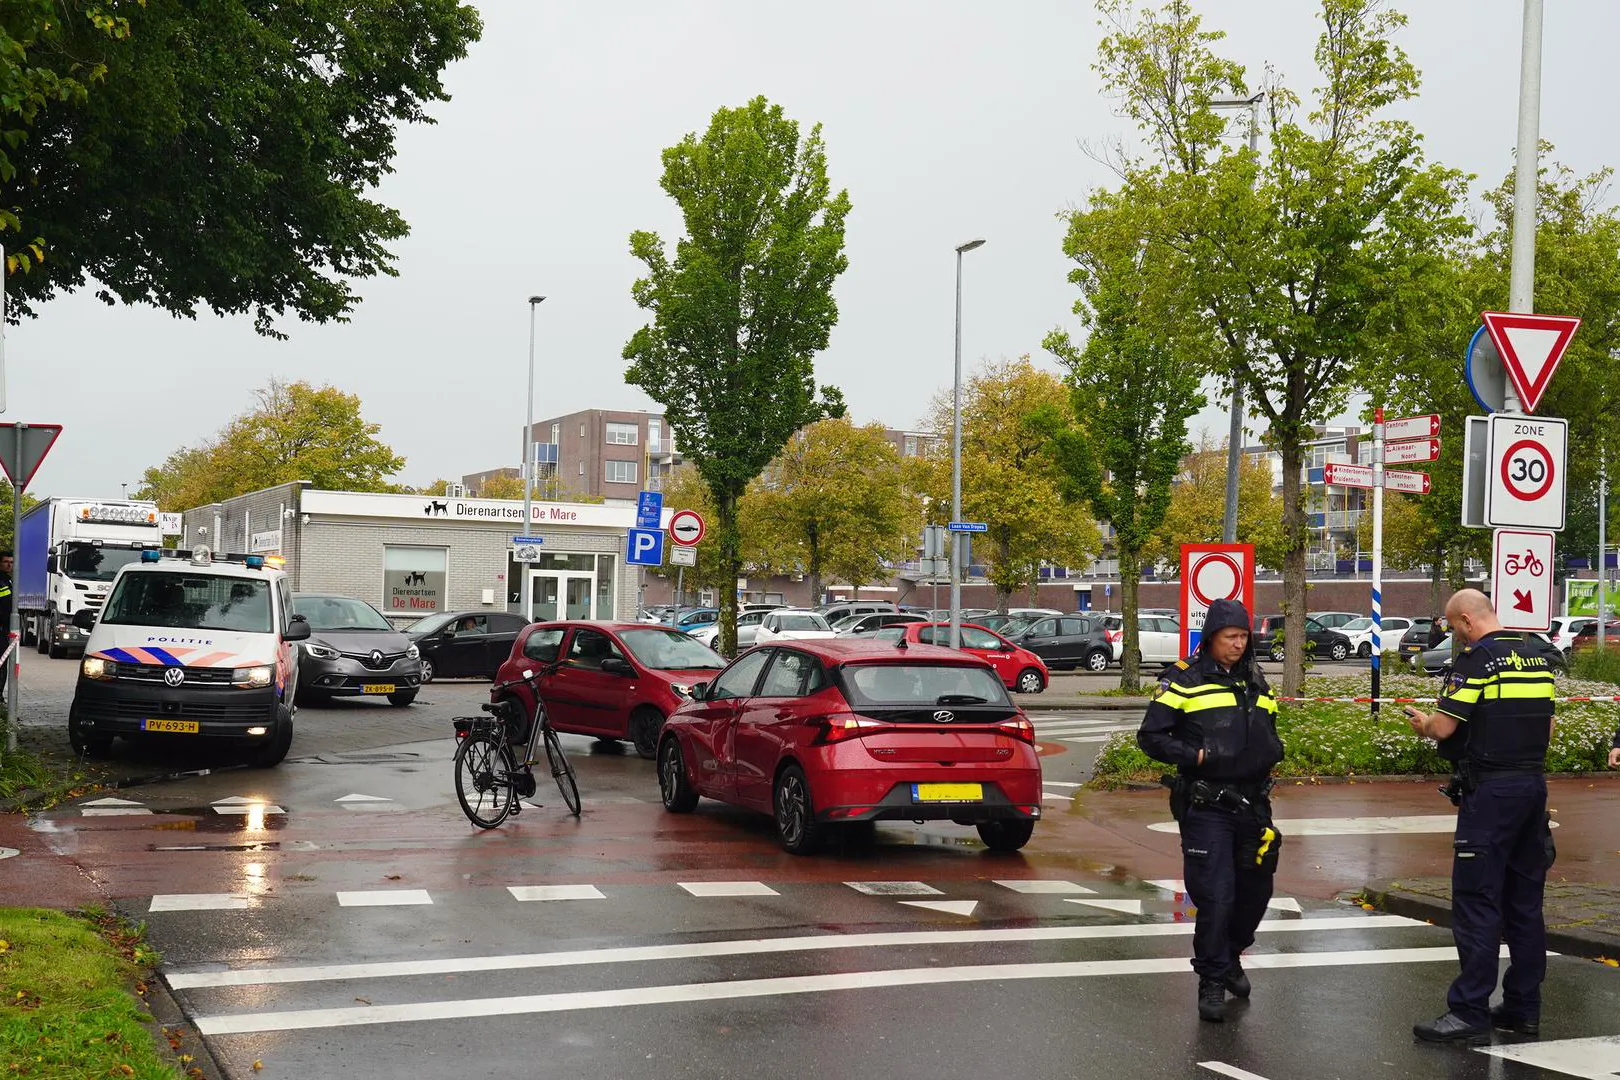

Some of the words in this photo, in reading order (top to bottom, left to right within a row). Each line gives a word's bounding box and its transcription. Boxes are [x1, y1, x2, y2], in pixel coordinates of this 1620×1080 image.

[1514, 424, 1545, 436] ZONE
[1511, 457, 1546, 483] 30
[456, 503, 525, 518] Dierenartsen
[532, 507, 546, 519] De
[550, 508, 577, 520] Mare
[634, 532, 656, 560] P
[392, 587, 436, 596] Dierenartsen
[513, 592, 520, 603] 7
[392, 597, 405, 608] De
[409, 597, 436, 609] Mare
[147, 637, 213, 646] POLITIE
[1505, 654, 1544, 671] POLITIE
[149, 721, 196, 732] PV-693-H
